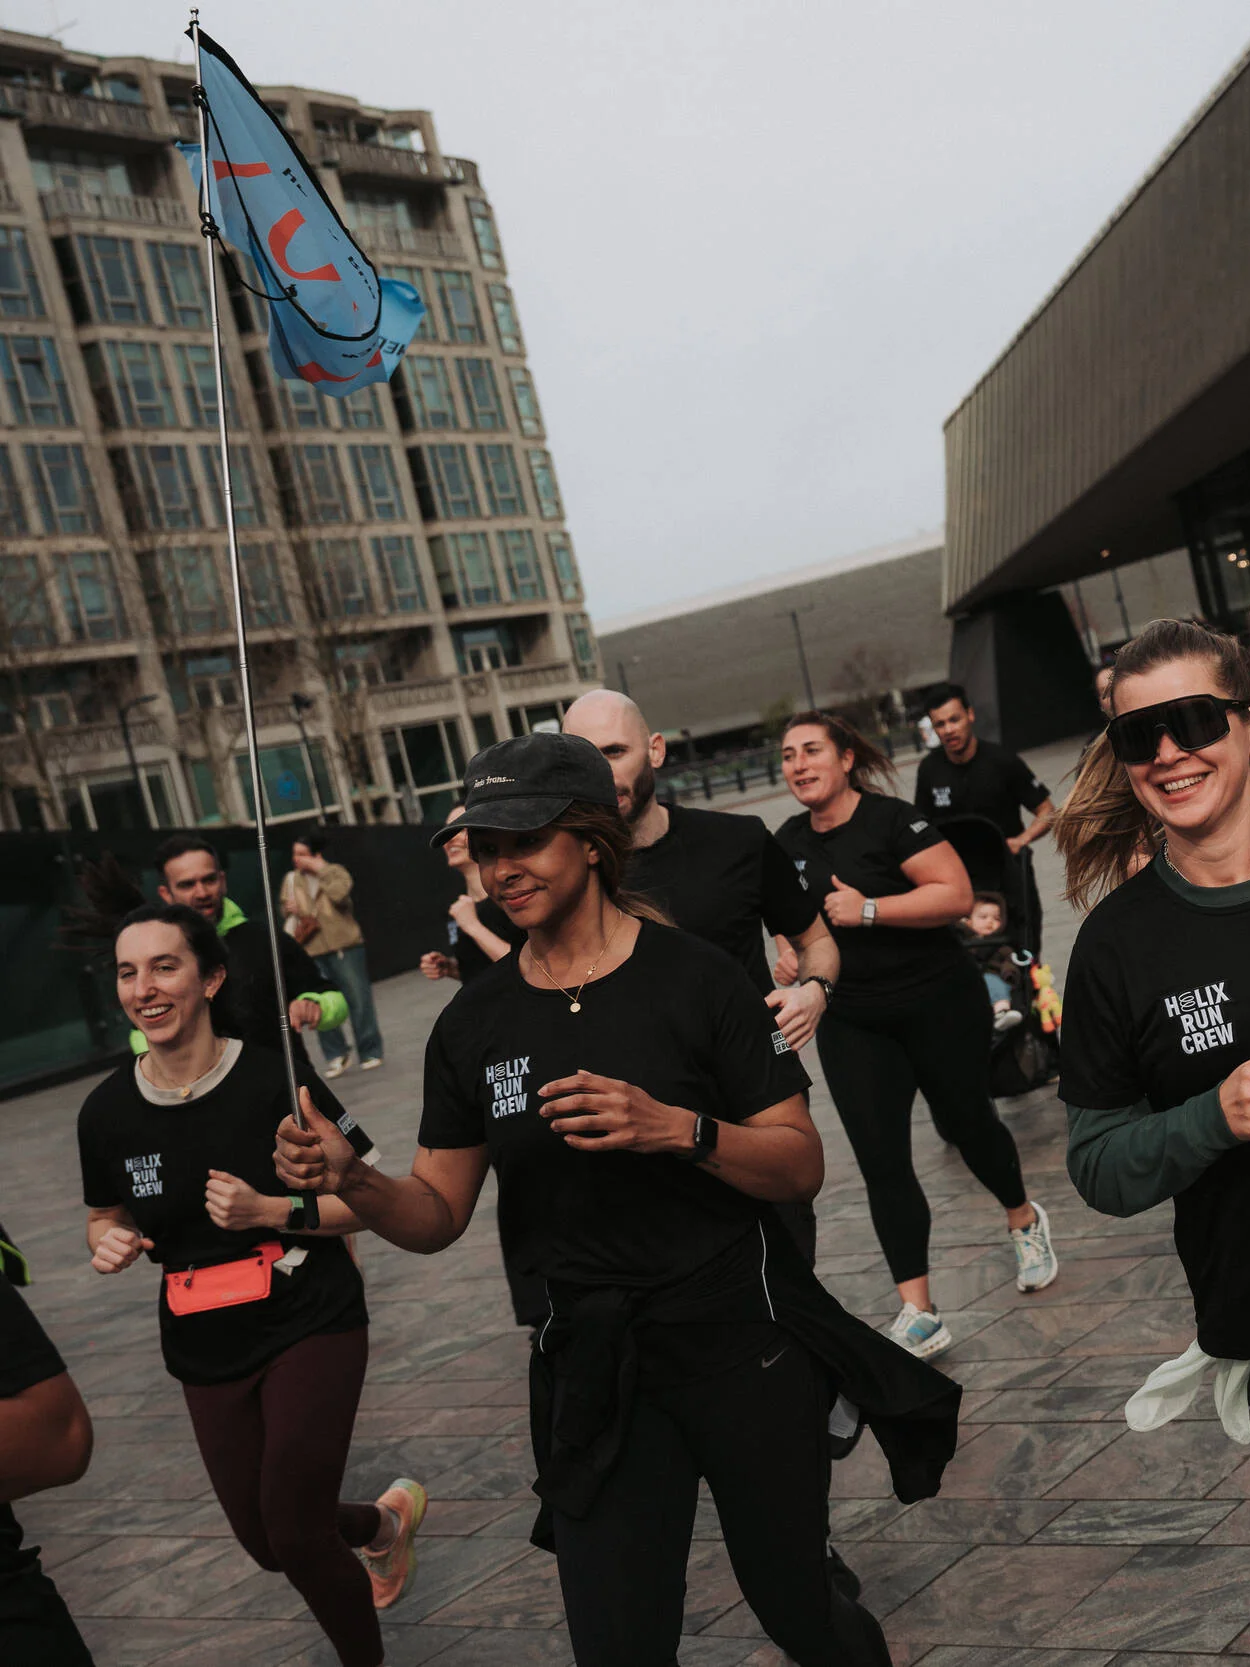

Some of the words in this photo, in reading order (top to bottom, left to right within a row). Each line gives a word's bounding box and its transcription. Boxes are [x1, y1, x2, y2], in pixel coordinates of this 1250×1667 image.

[1164, 981, 1230, 1018] HELIX
[1180, 1004, 1225, 1034] RUN
[1181, 1022, 1234, 1055] CREW
[485, 1056, 530, 1084] HELIX
[493, 1077, 523, 1100] RUN
[491, 1093, 528, 1119] CREW
[124, 1153, 162, 1173] HELIX
[132, 1168, 159, 1185] RUN
[132, 1181, 163, 1198] CREW
